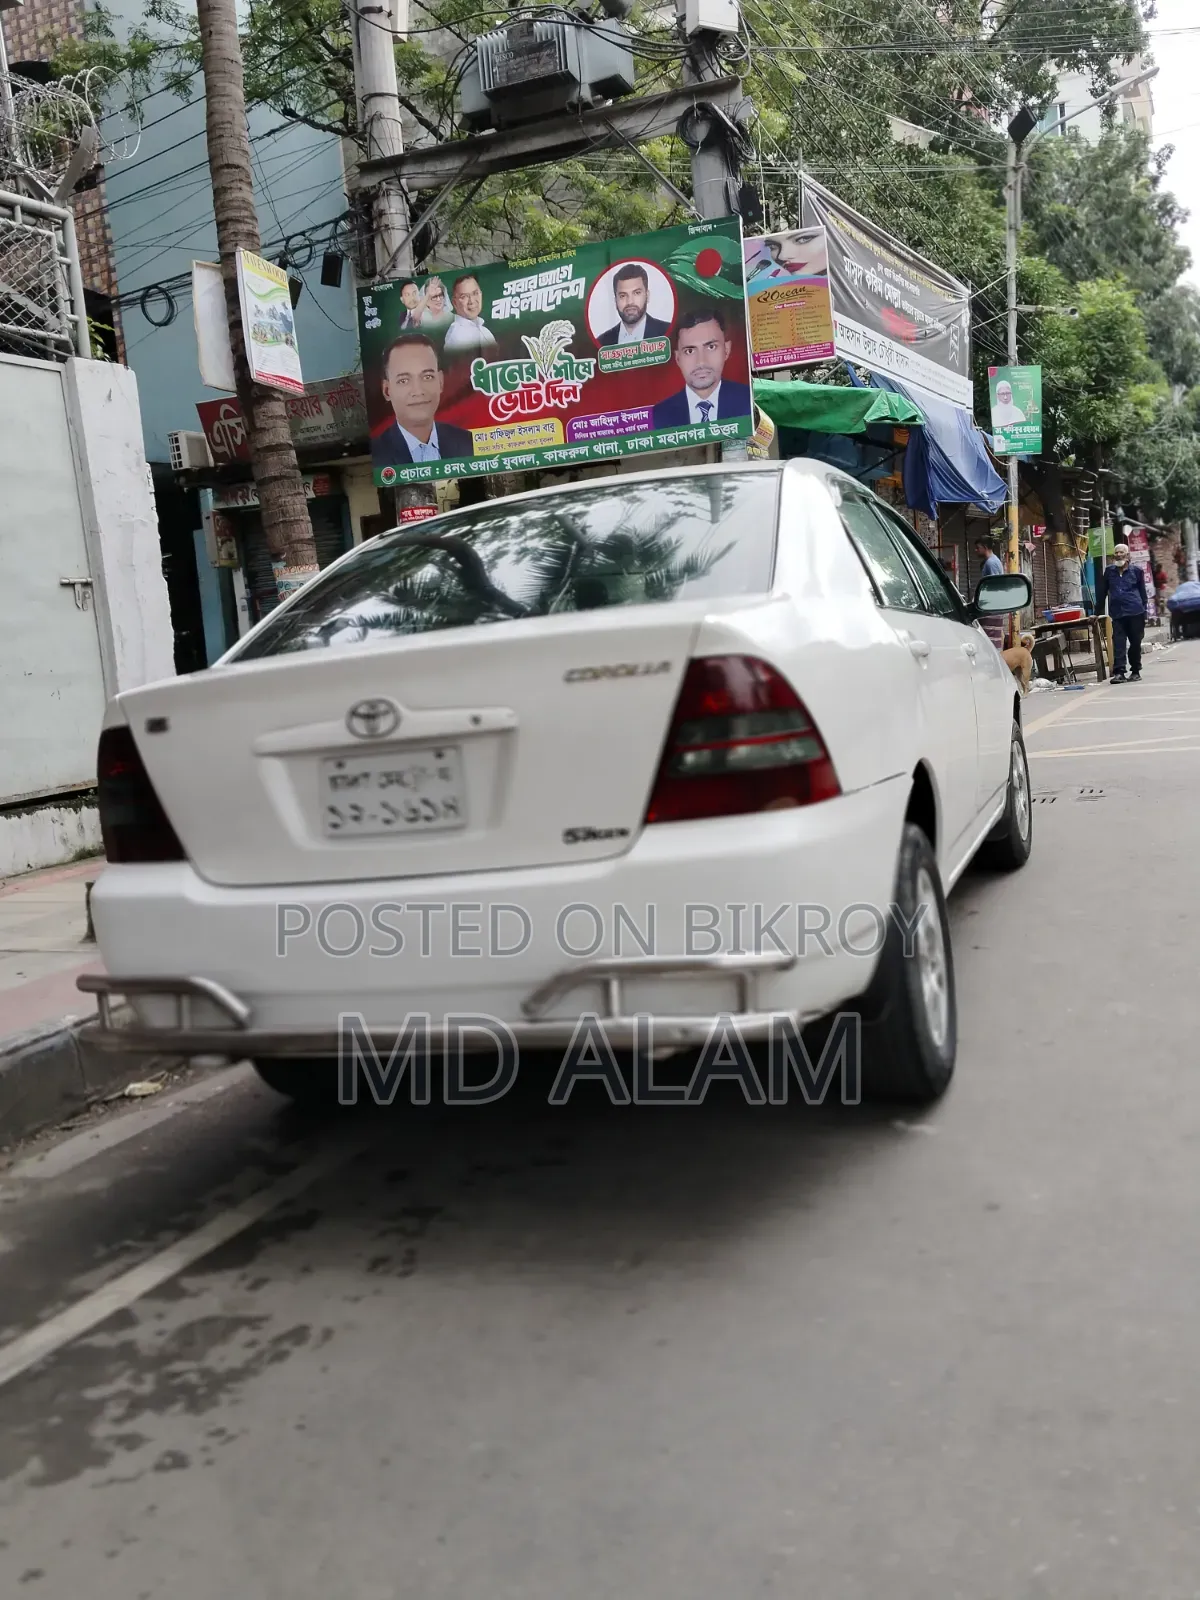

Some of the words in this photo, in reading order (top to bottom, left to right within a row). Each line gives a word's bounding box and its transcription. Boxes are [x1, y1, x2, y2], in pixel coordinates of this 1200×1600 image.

[503, 274, 538, 296] সবার
[539, 263, 573, 286] আগে
[770, 286, 806, 300] Ocean
[864, 264, 883, 298] করিম
[491, 277, 586, 319] বাংলাদেশ
[640, 339, 667, 354] মিরাজ
[838, 322, 861, 348] আহসান
[862, 331, 878, 357] উল্লাহ
[879, 340, 894, 366] চৌধুরী
[471, 358, 540, 395] ধানের
[552, 352, 596, 382] শীষে
[489, 379, 544, 421] ভোট
[543, 377, 583, 409] দিন
[474, 432, 488, 442] মোঃ
[489, 427, 516, 440] হাফিজুল
[517, 423, 541, 436] ইসলাম
[542, 421, 555, 433] বাবু
[572, 419, 588, 430] মোঃ
[589, 415, 620, 427] জাহিদুল
[621, 410, 649, 423] ইসলাম
[399, 466, 432, 481] প্রচারে
[443, 463, 467, 475] ৪নং
[469, 454, 500, 471] ওয়ার্ড
[502, 452, 540, 471] যুবদল,
[542, 445, 589, 462] কাফরুল
[592, 440, 623, 455] থানা,
[625, 434, 654, 450] ঢাকা
[656, 427, 706, 446] মহানগর
[709, 421, 740, 439] উত্তর
[562, 661, 671, 683] COROLLA
